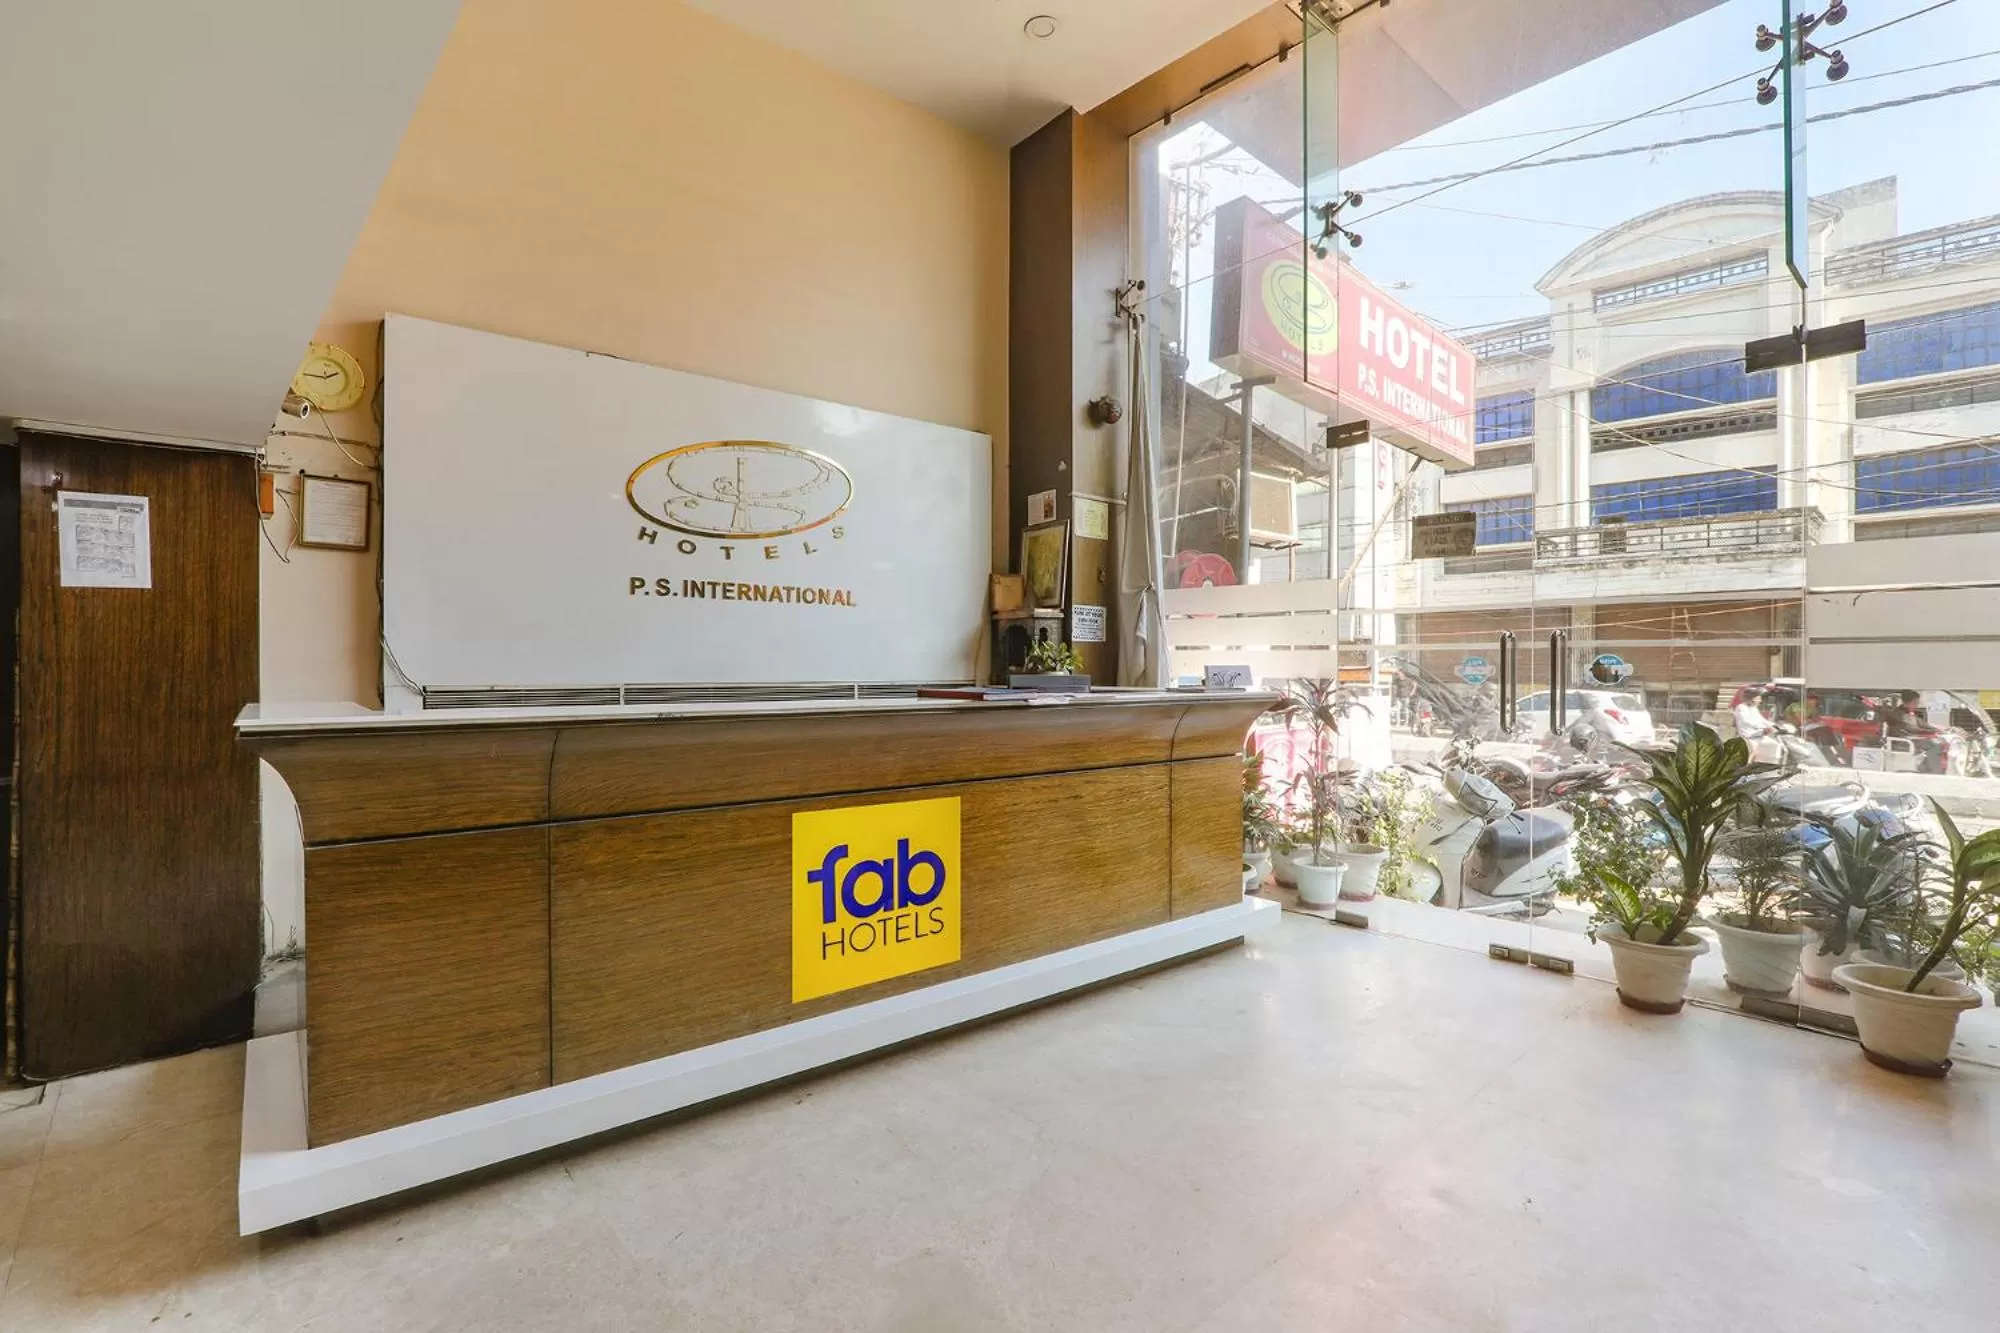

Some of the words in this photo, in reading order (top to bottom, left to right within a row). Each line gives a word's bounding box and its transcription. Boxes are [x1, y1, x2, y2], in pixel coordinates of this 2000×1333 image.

[1280, 317, 1324, 351] HOTLS
[1360, 295, 1465, 406] HOTEL
[1358, 361, 1379, 399] P.S.
[1383, 375, 1468, 444] INTERNATIONAL
[638, 526, 845, 560] HOTELS
[807, 838, 946, 924] fab
[822, 907, 945, 961] HOTELS
